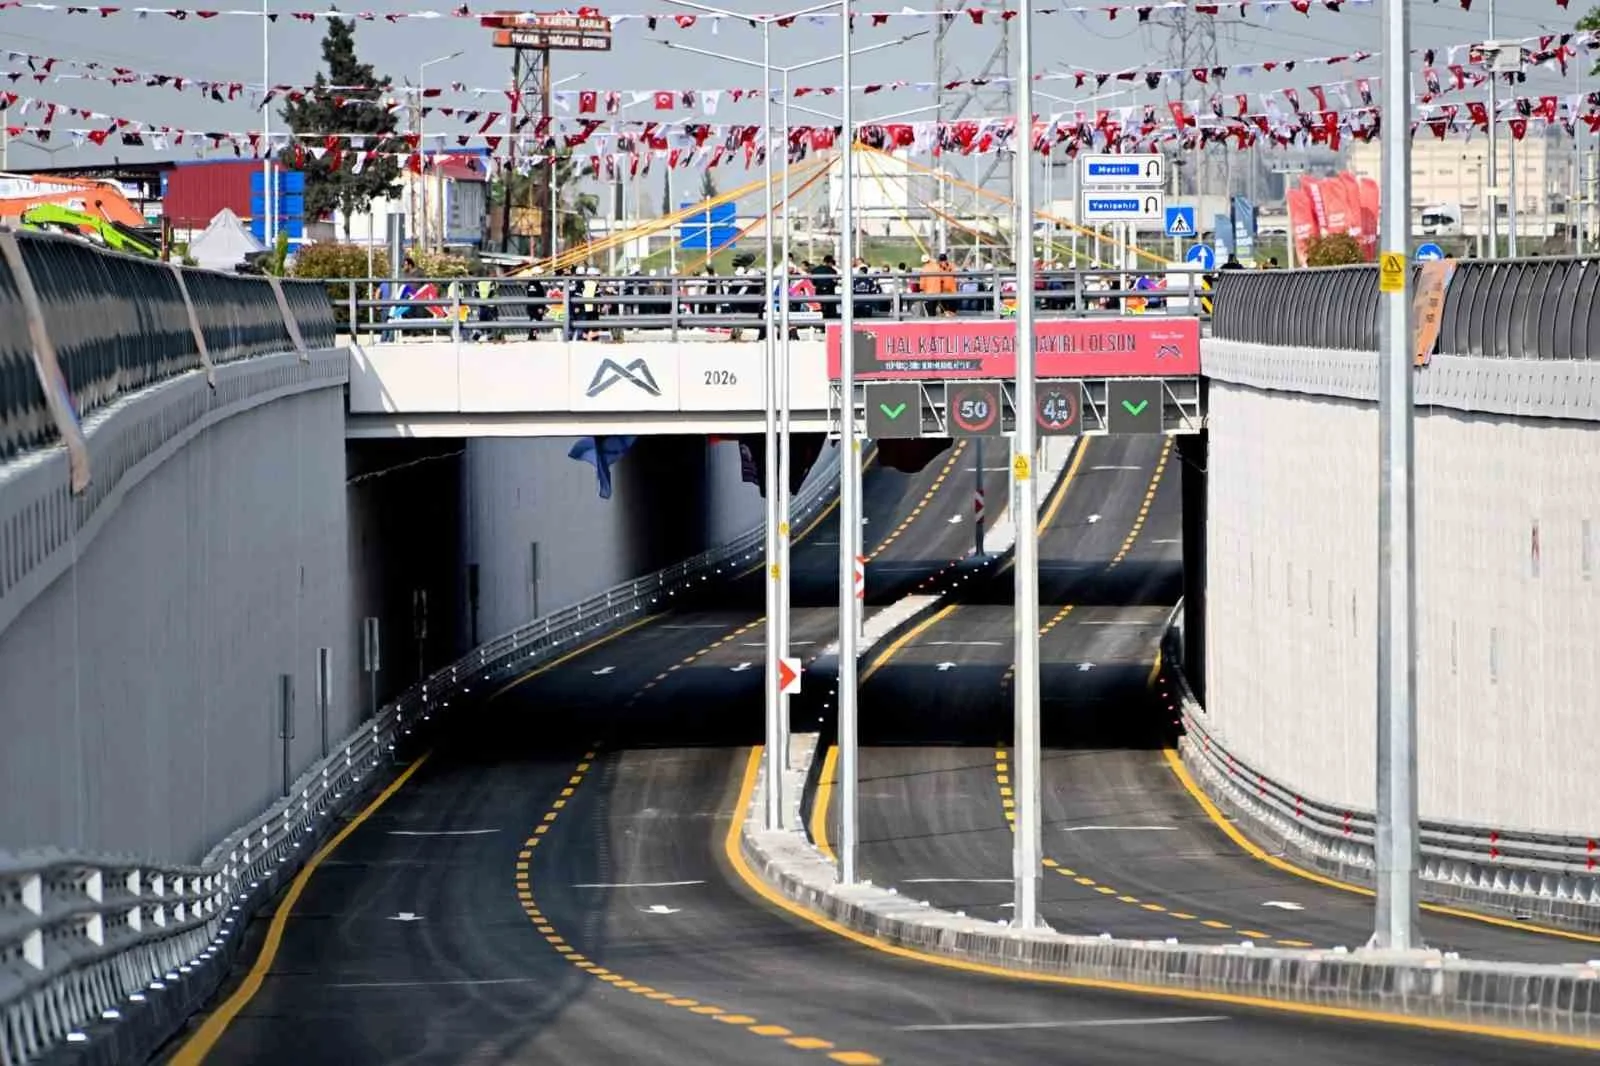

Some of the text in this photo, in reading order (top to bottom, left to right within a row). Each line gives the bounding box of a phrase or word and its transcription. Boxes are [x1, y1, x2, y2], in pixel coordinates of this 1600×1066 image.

[1097, 165, 1130, 173] Mezitli
[885, 335, 912, 354] HAL
[918, 335, 958, 354] KATLI
[1088, 333, 1136, 352] OLSUN
[703, 370, 737, 385] 2026
[960, 400, 988, 418] 50
